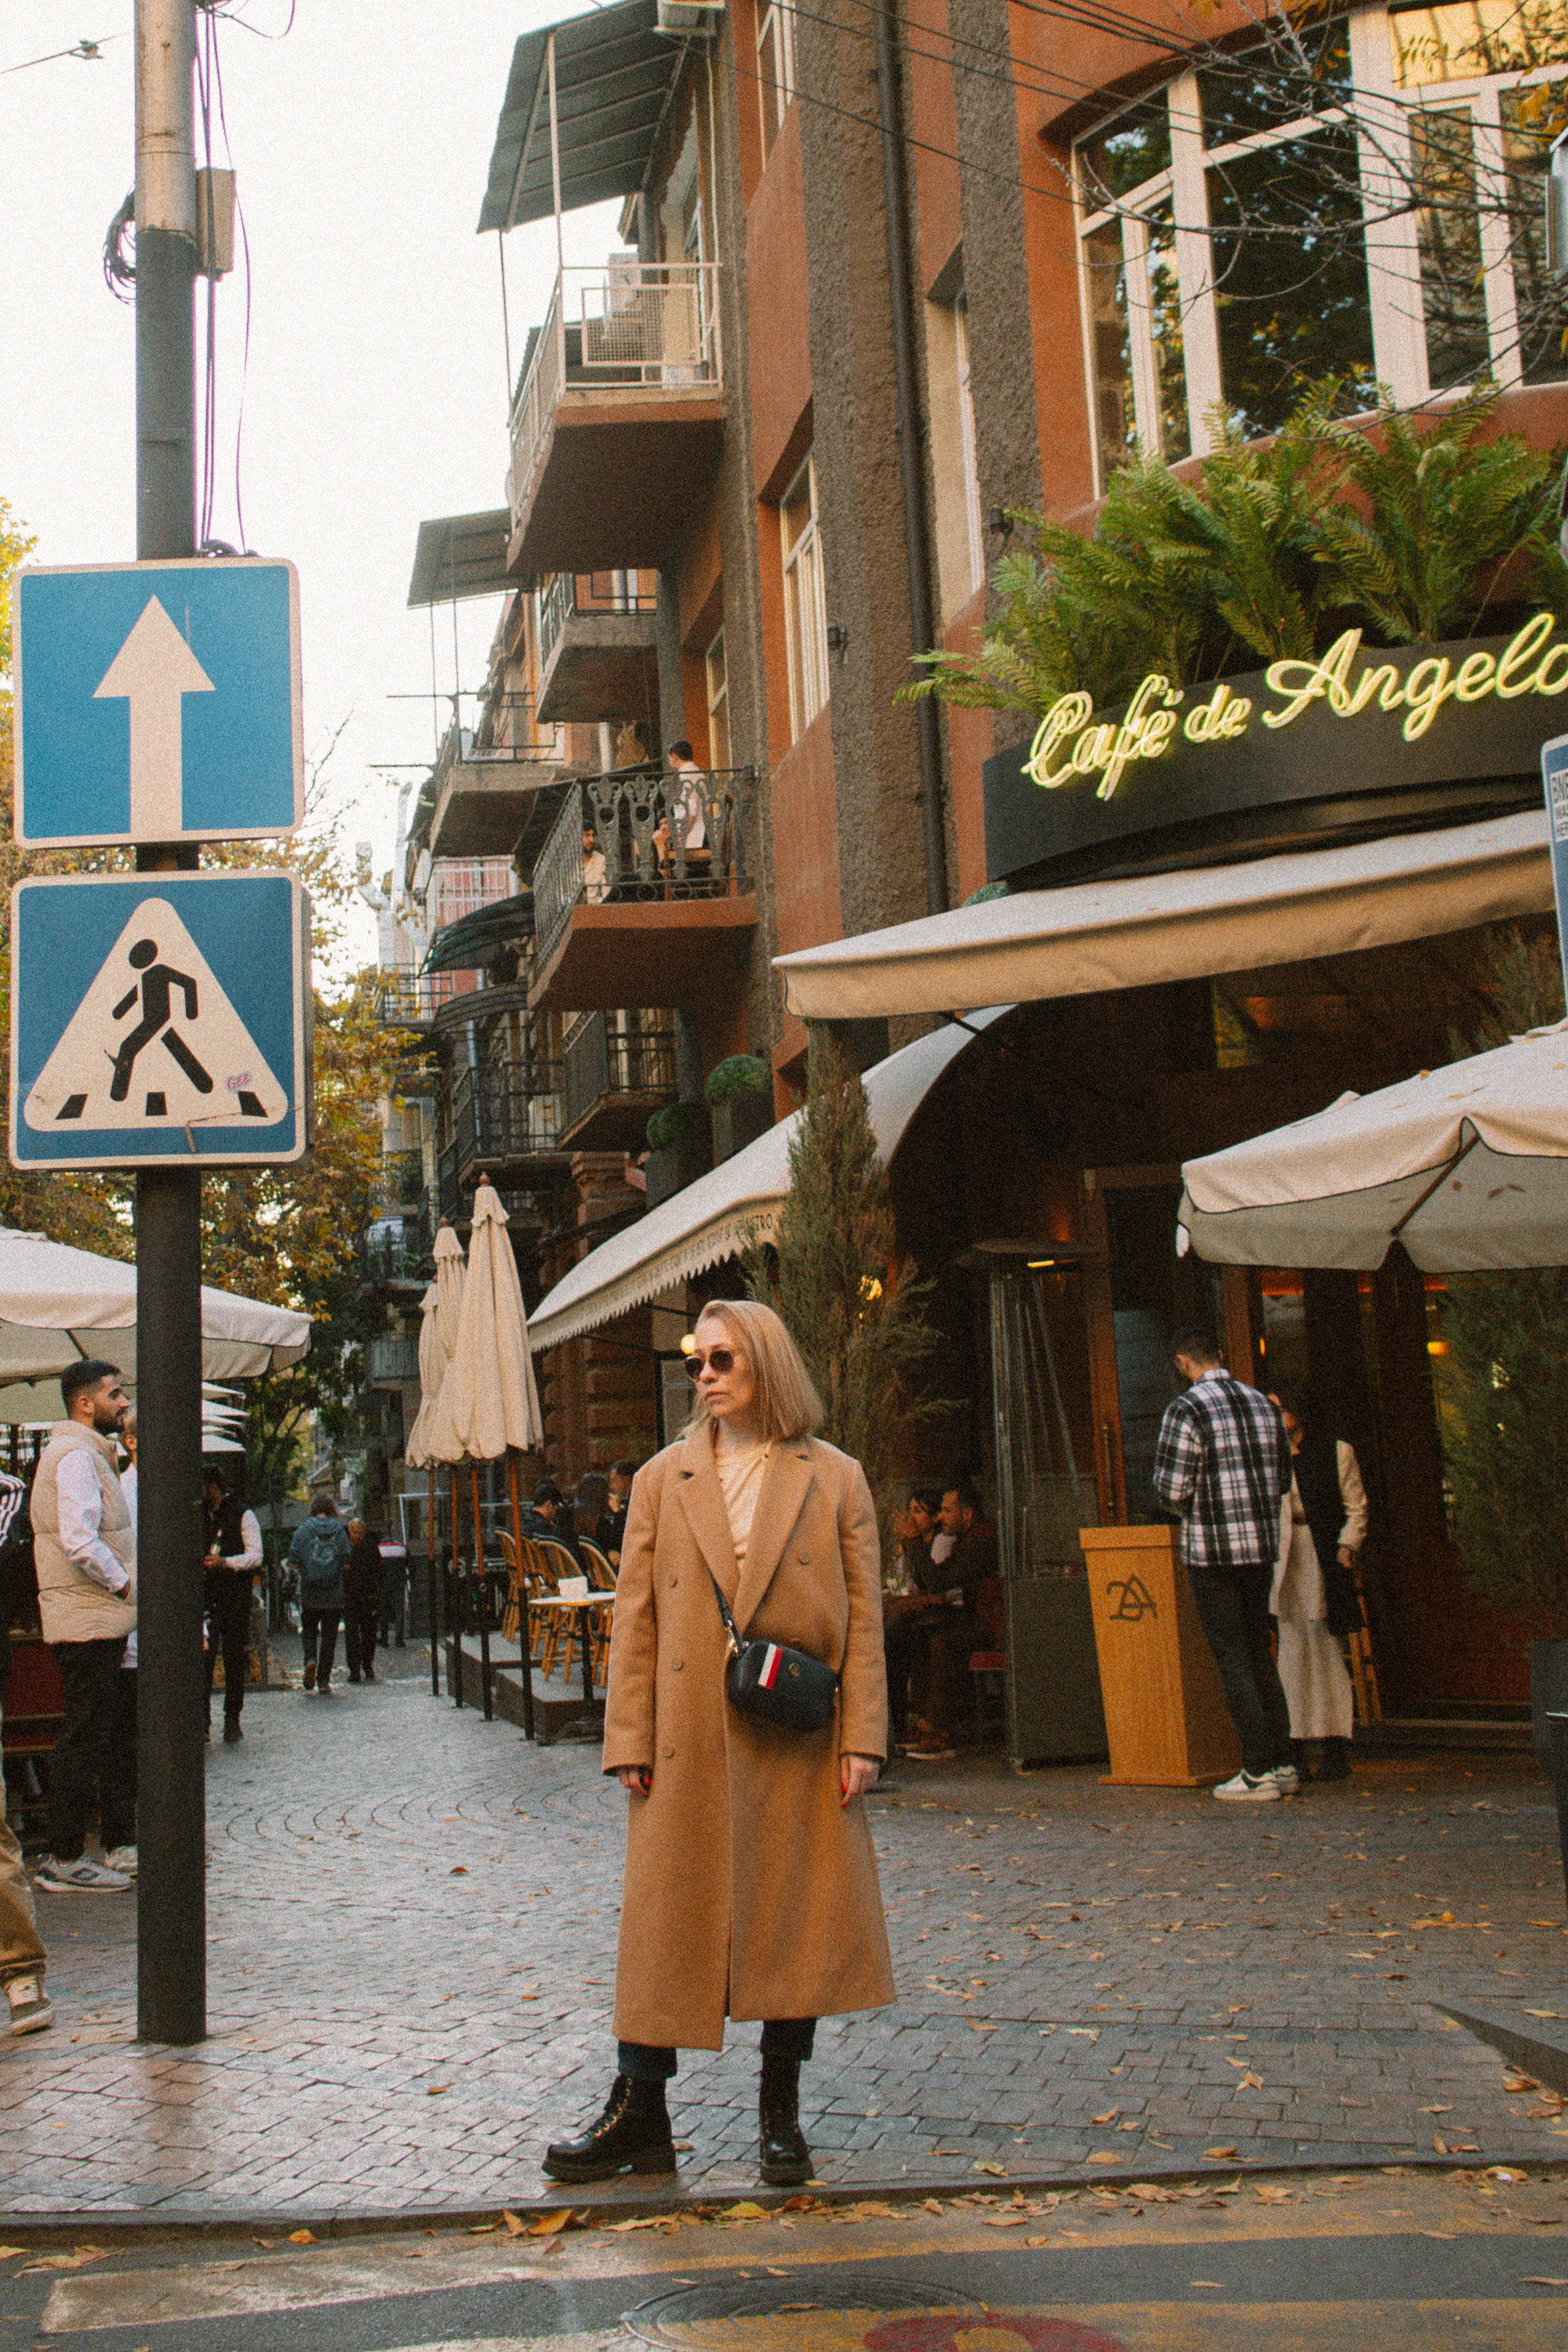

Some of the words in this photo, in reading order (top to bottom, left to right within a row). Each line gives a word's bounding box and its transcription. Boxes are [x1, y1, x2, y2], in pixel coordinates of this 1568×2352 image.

[1020, 673, 1184, 801] Café
[1184, 685, 1252, 742] de
[1262, 613, 1568, 742] Angelo
